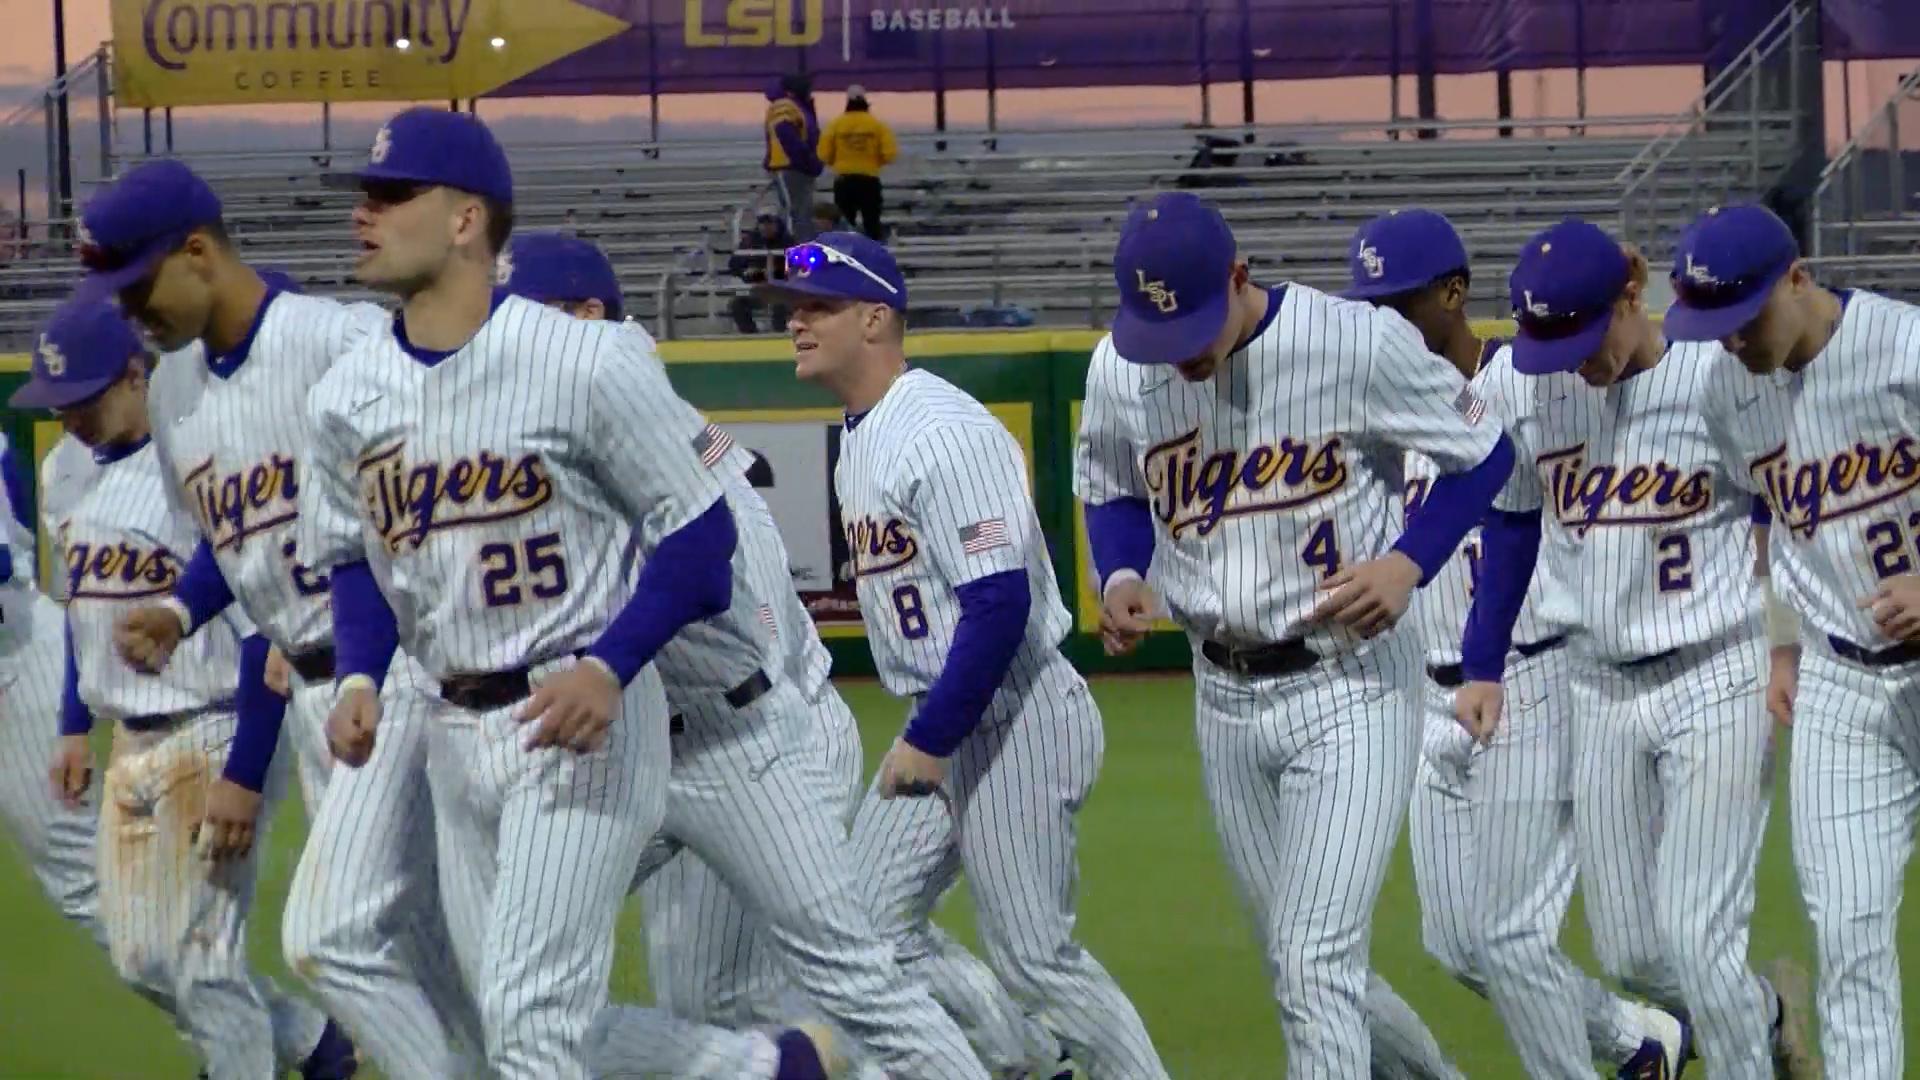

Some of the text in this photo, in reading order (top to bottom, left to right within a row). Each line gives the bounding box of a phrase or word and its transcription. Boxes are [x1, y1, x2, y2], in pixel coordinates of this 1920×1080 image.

[142, 0, 471, 69] Community
[684, 0, 823, 46] LSU
[870, 8, 1015, 31] BASEBALL
[235, 70, 380, 90] COFFEE
[1136, 269, 1179, 313] LSU
[184, 454, 300, 554] Tiger
[359, 440, 553, 551] Tigers
[1144, 427, 1347, 540] Tigers
[1535, 440, 1712, 537] Tigers
[1749, 438, 1920, 541] Tigers
[58, 518, 179, 604] gers
[480, 532, 569, 608] 25
[1301, 519, 1342, 578] 4
[1657, 533, 1693, 593] 2
[1866, 508, 1920, 579] 2
[892, 584, 929, 640] 8
